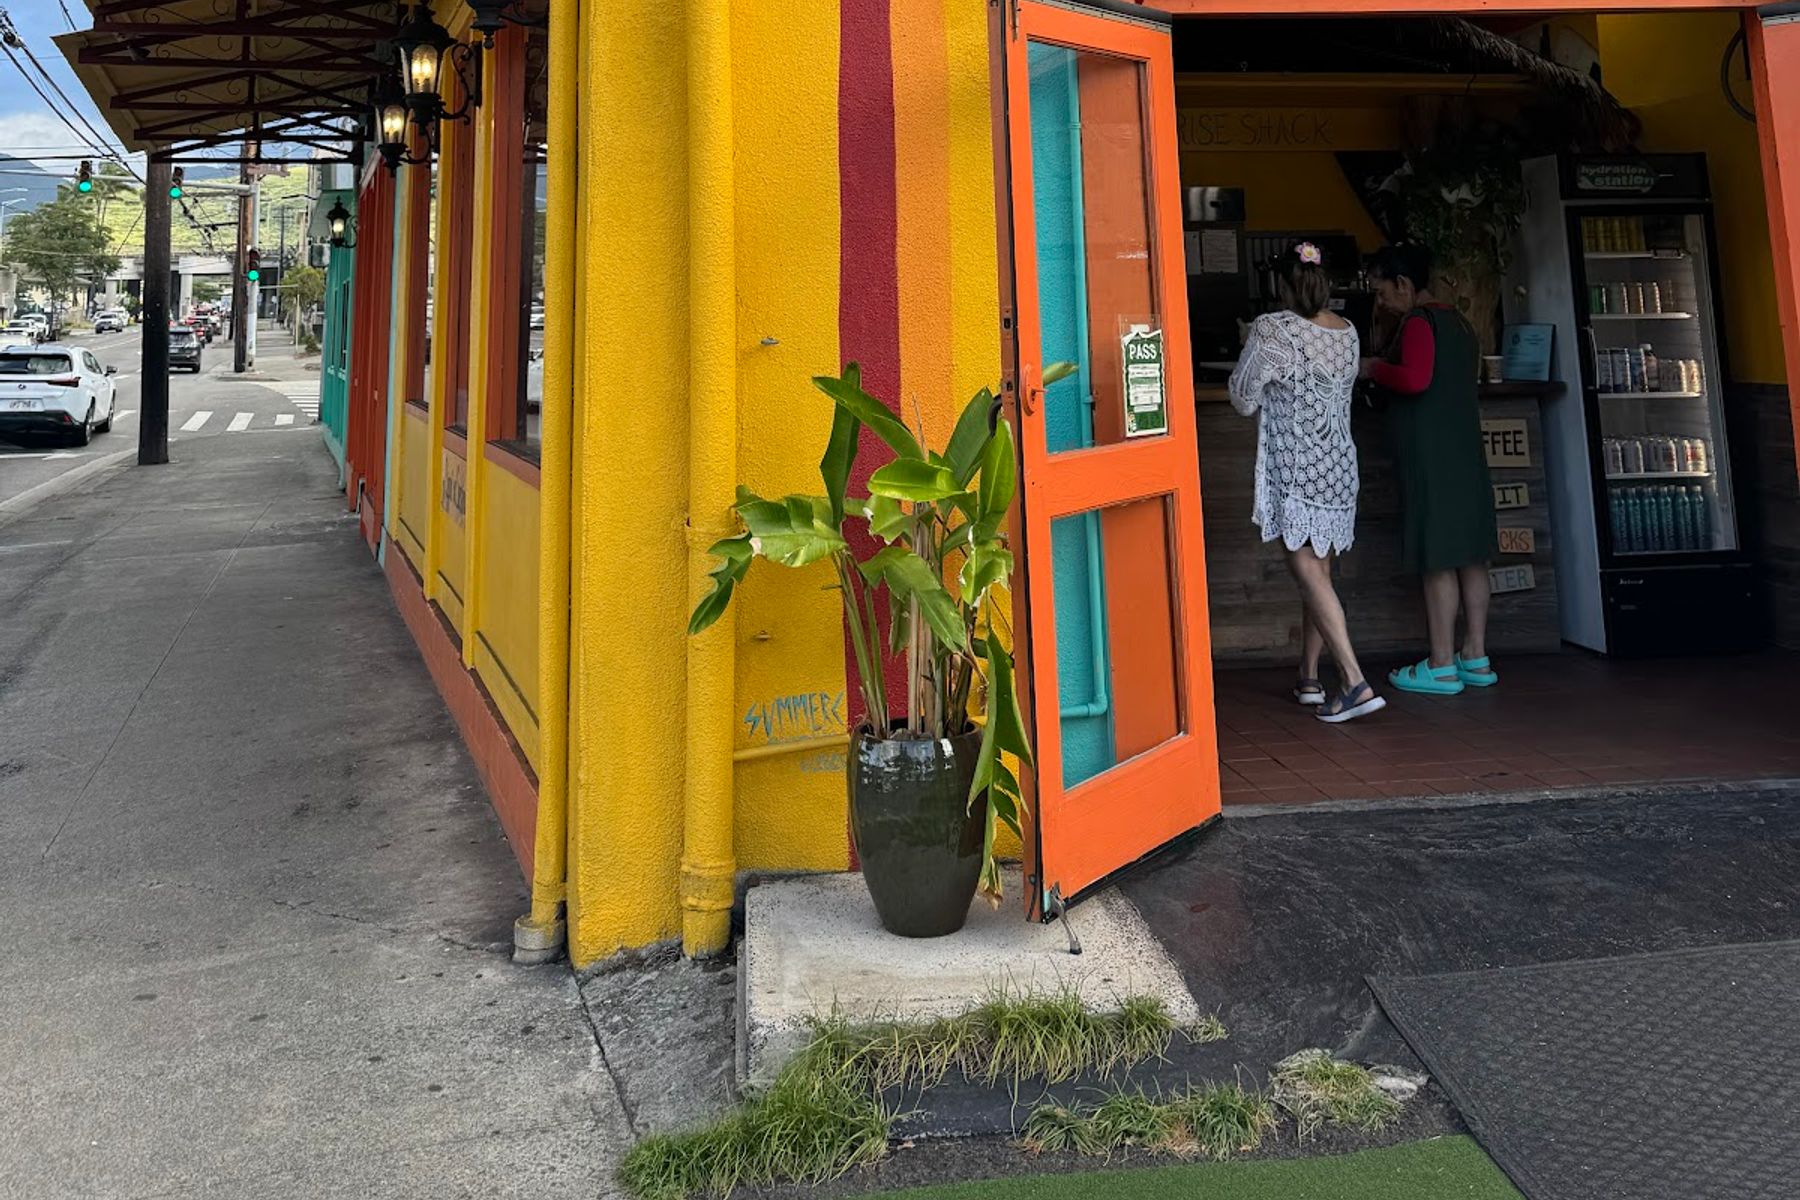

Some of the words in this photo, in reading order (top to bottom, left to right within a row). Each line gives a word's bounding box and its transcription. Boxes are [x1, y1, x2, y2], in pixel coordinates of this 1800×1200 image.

[1178, 112, 1232, 145] RISE
[1239, 112, 1334, 145] SHACK
[1580, 165, 1647, 176] hydration
[1594, 175, 1655, 186] station
[1129, 343, 1157, 360] PASS
[1499, 530, 1530, 551] CKS
